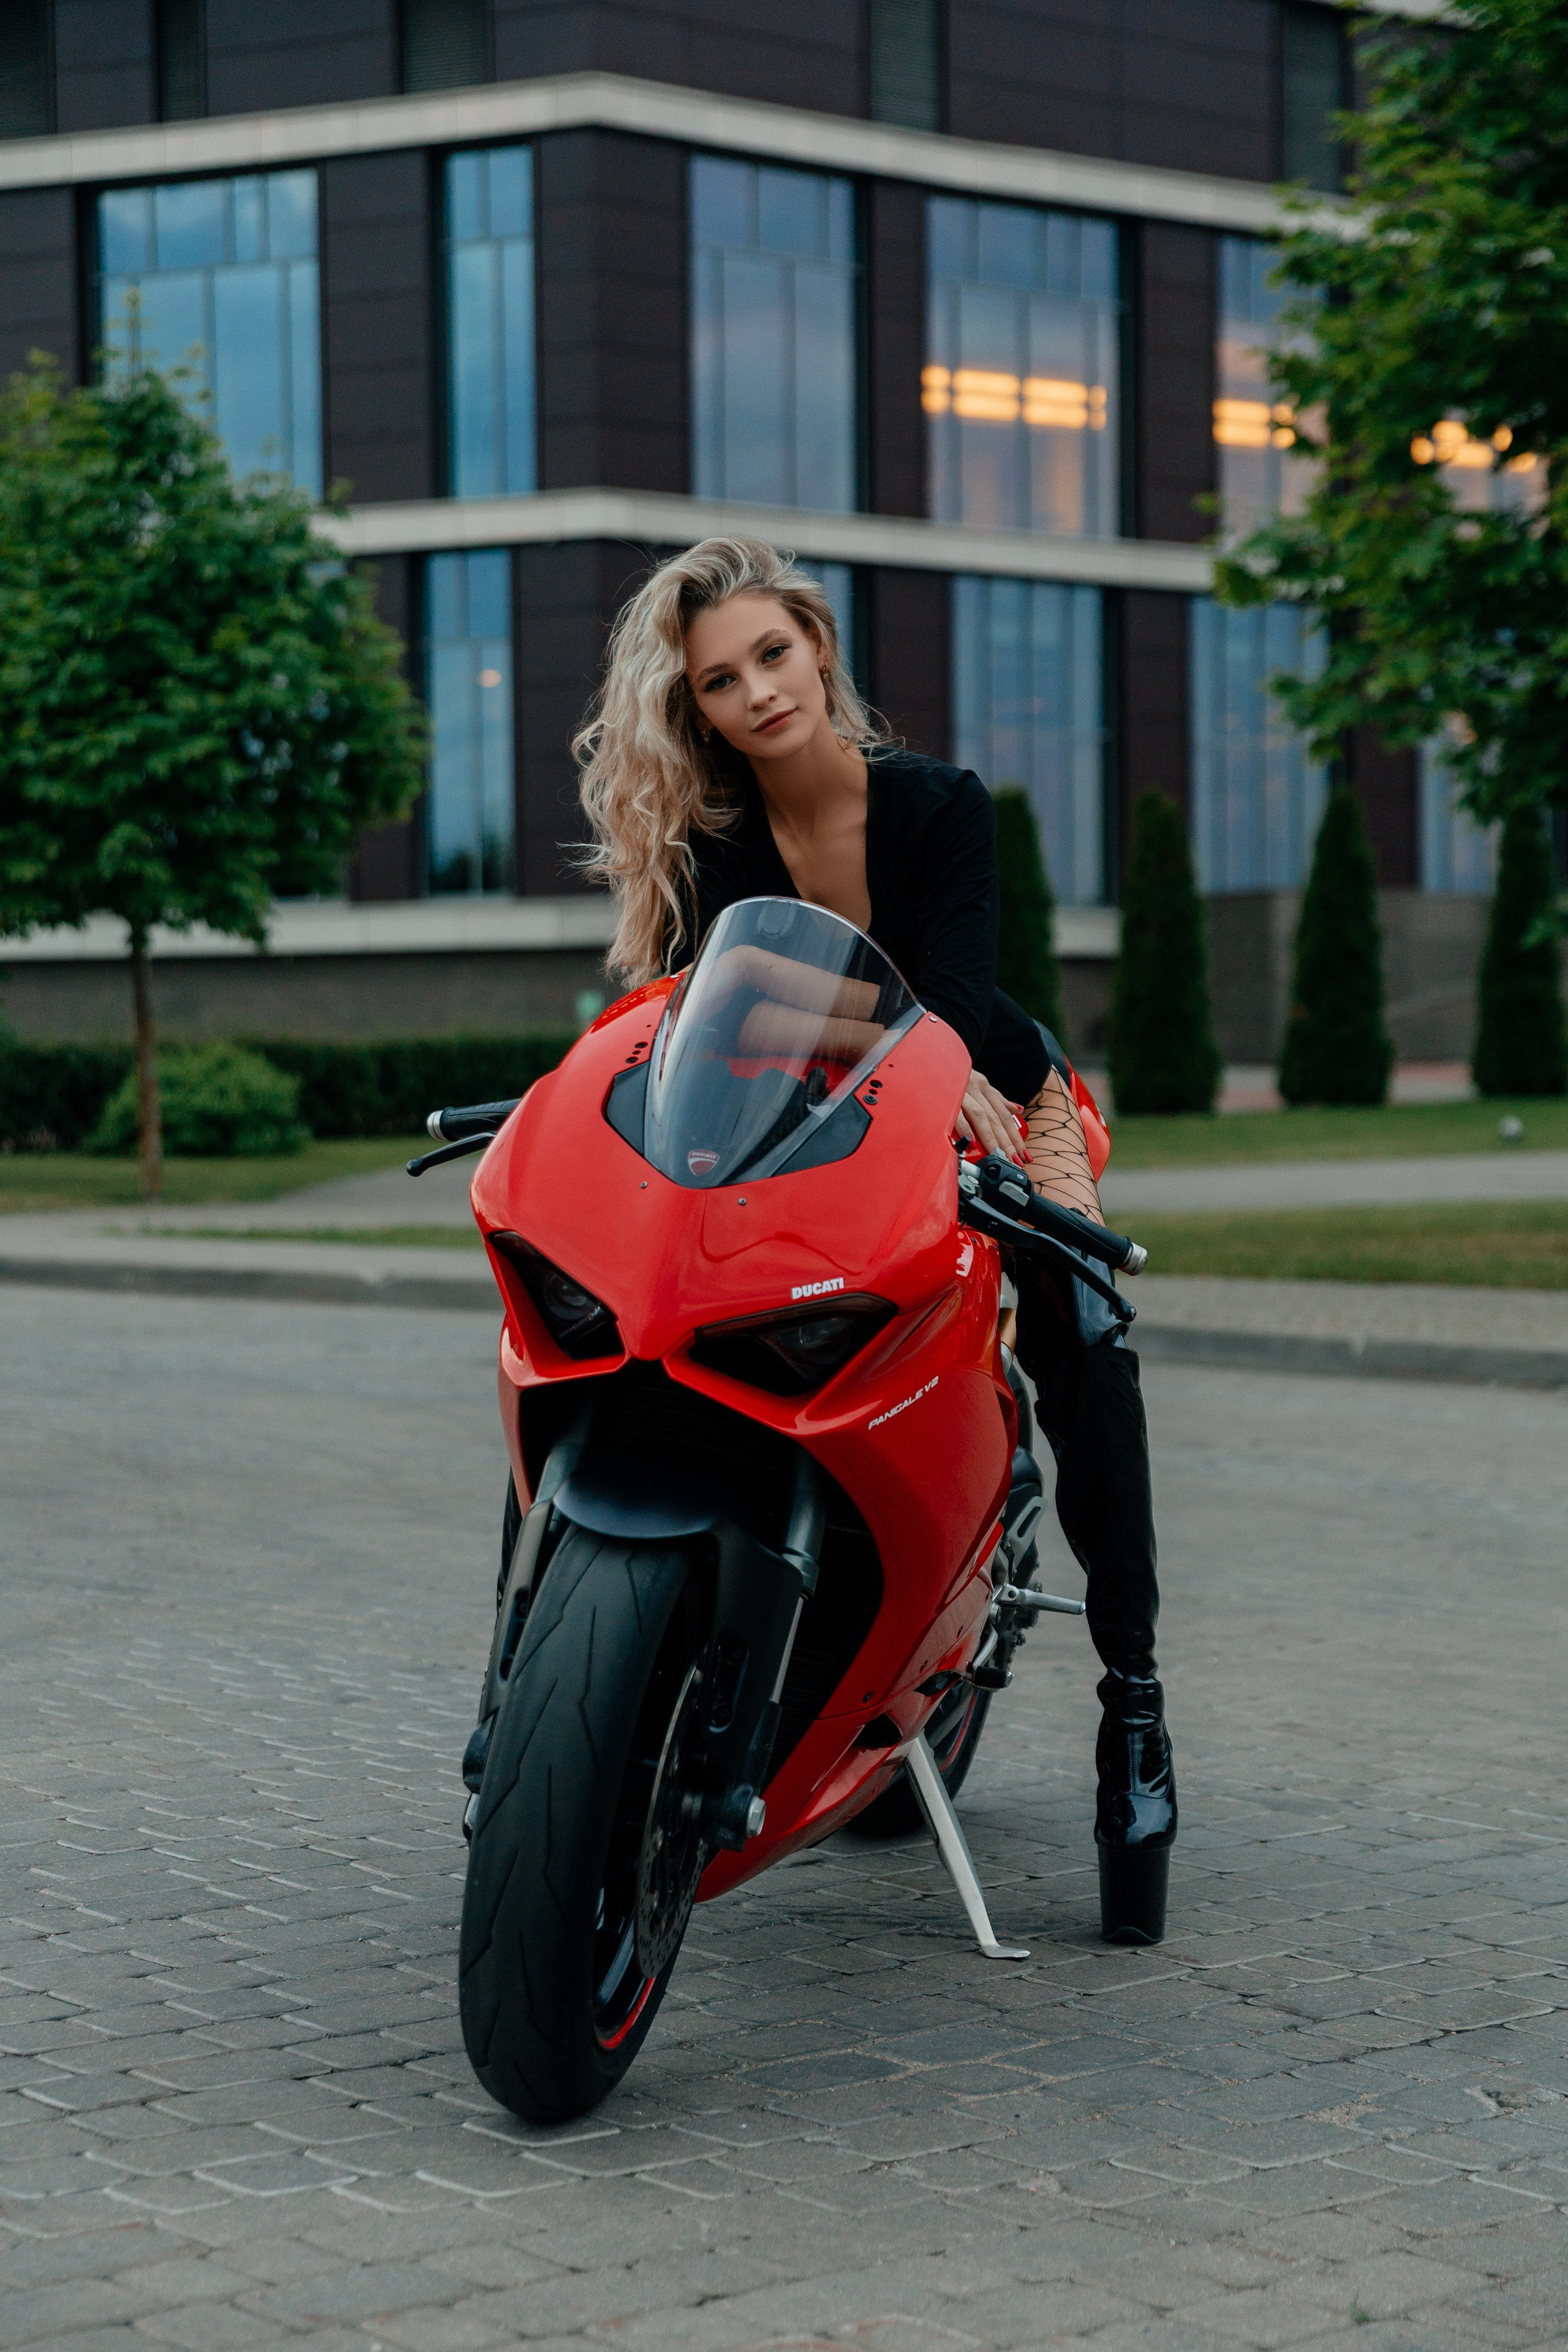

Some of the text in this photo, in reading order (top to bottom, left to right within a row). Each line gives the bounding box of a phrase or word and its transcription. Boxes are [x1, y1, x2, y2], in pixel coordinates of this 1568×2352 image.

[791, 1277, 845, 1300] DUCATI
[868, 1375, 939, 1430] PANIGALE V2
